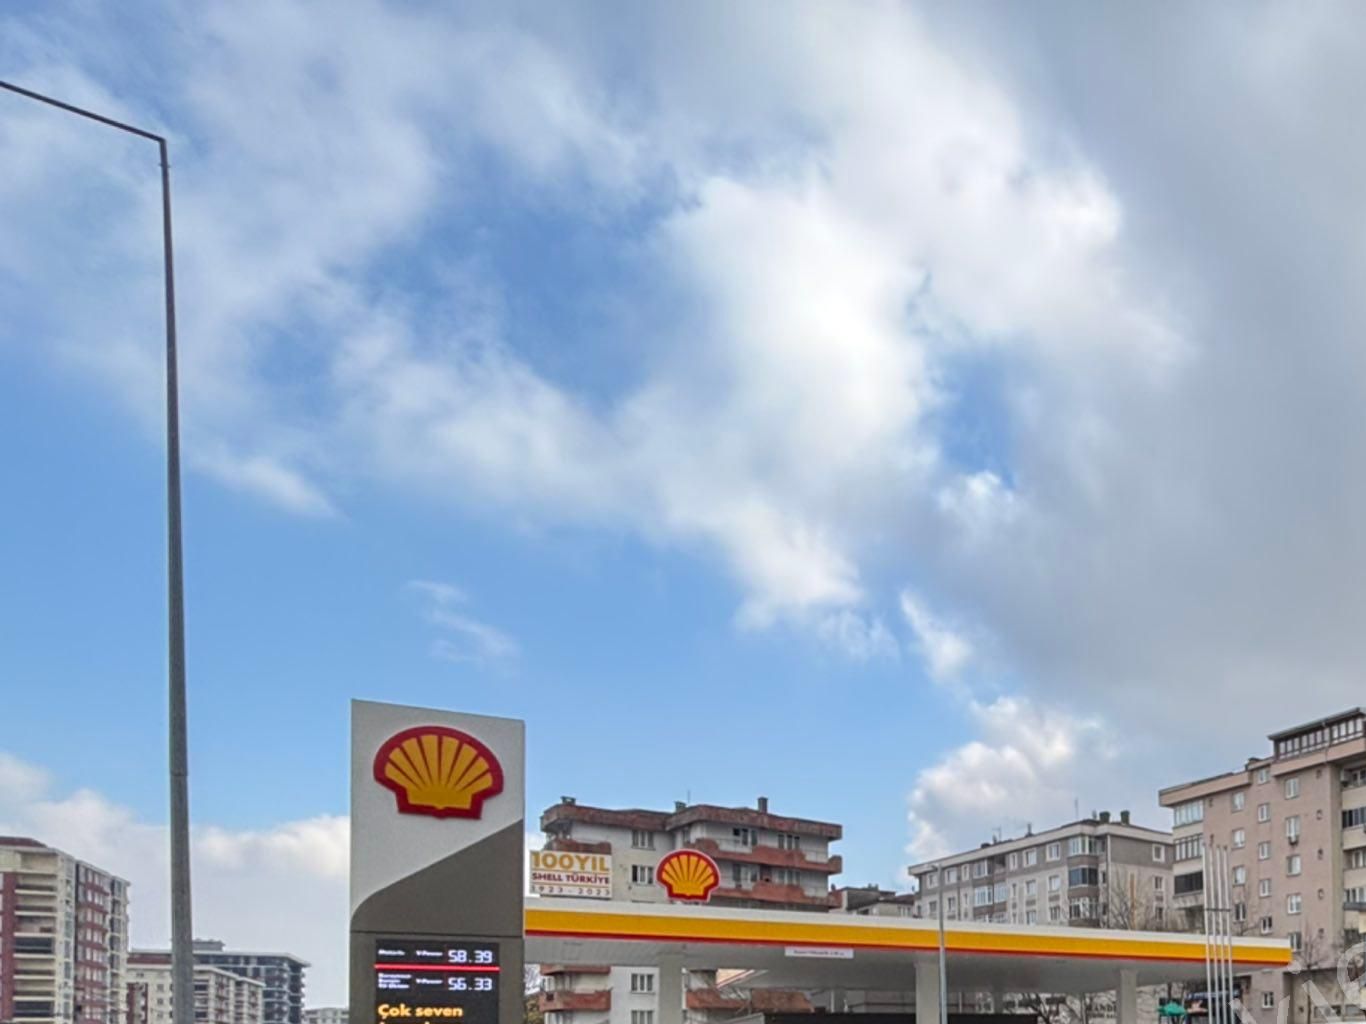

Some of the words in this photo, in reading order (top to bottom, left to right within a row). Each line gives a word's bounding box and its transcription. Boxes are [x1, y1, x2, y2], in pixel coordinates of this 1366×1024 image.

[532, 873, 563, 882] SHELL
[565, 871, 609, 884] TÜRKİYE
[448, 950, 493, 963] 58.39
[448, 977, 493, 991] 56.33
[378, 1004, 412, 1019] Çok
[415, 1007, 463, 1017] seven
